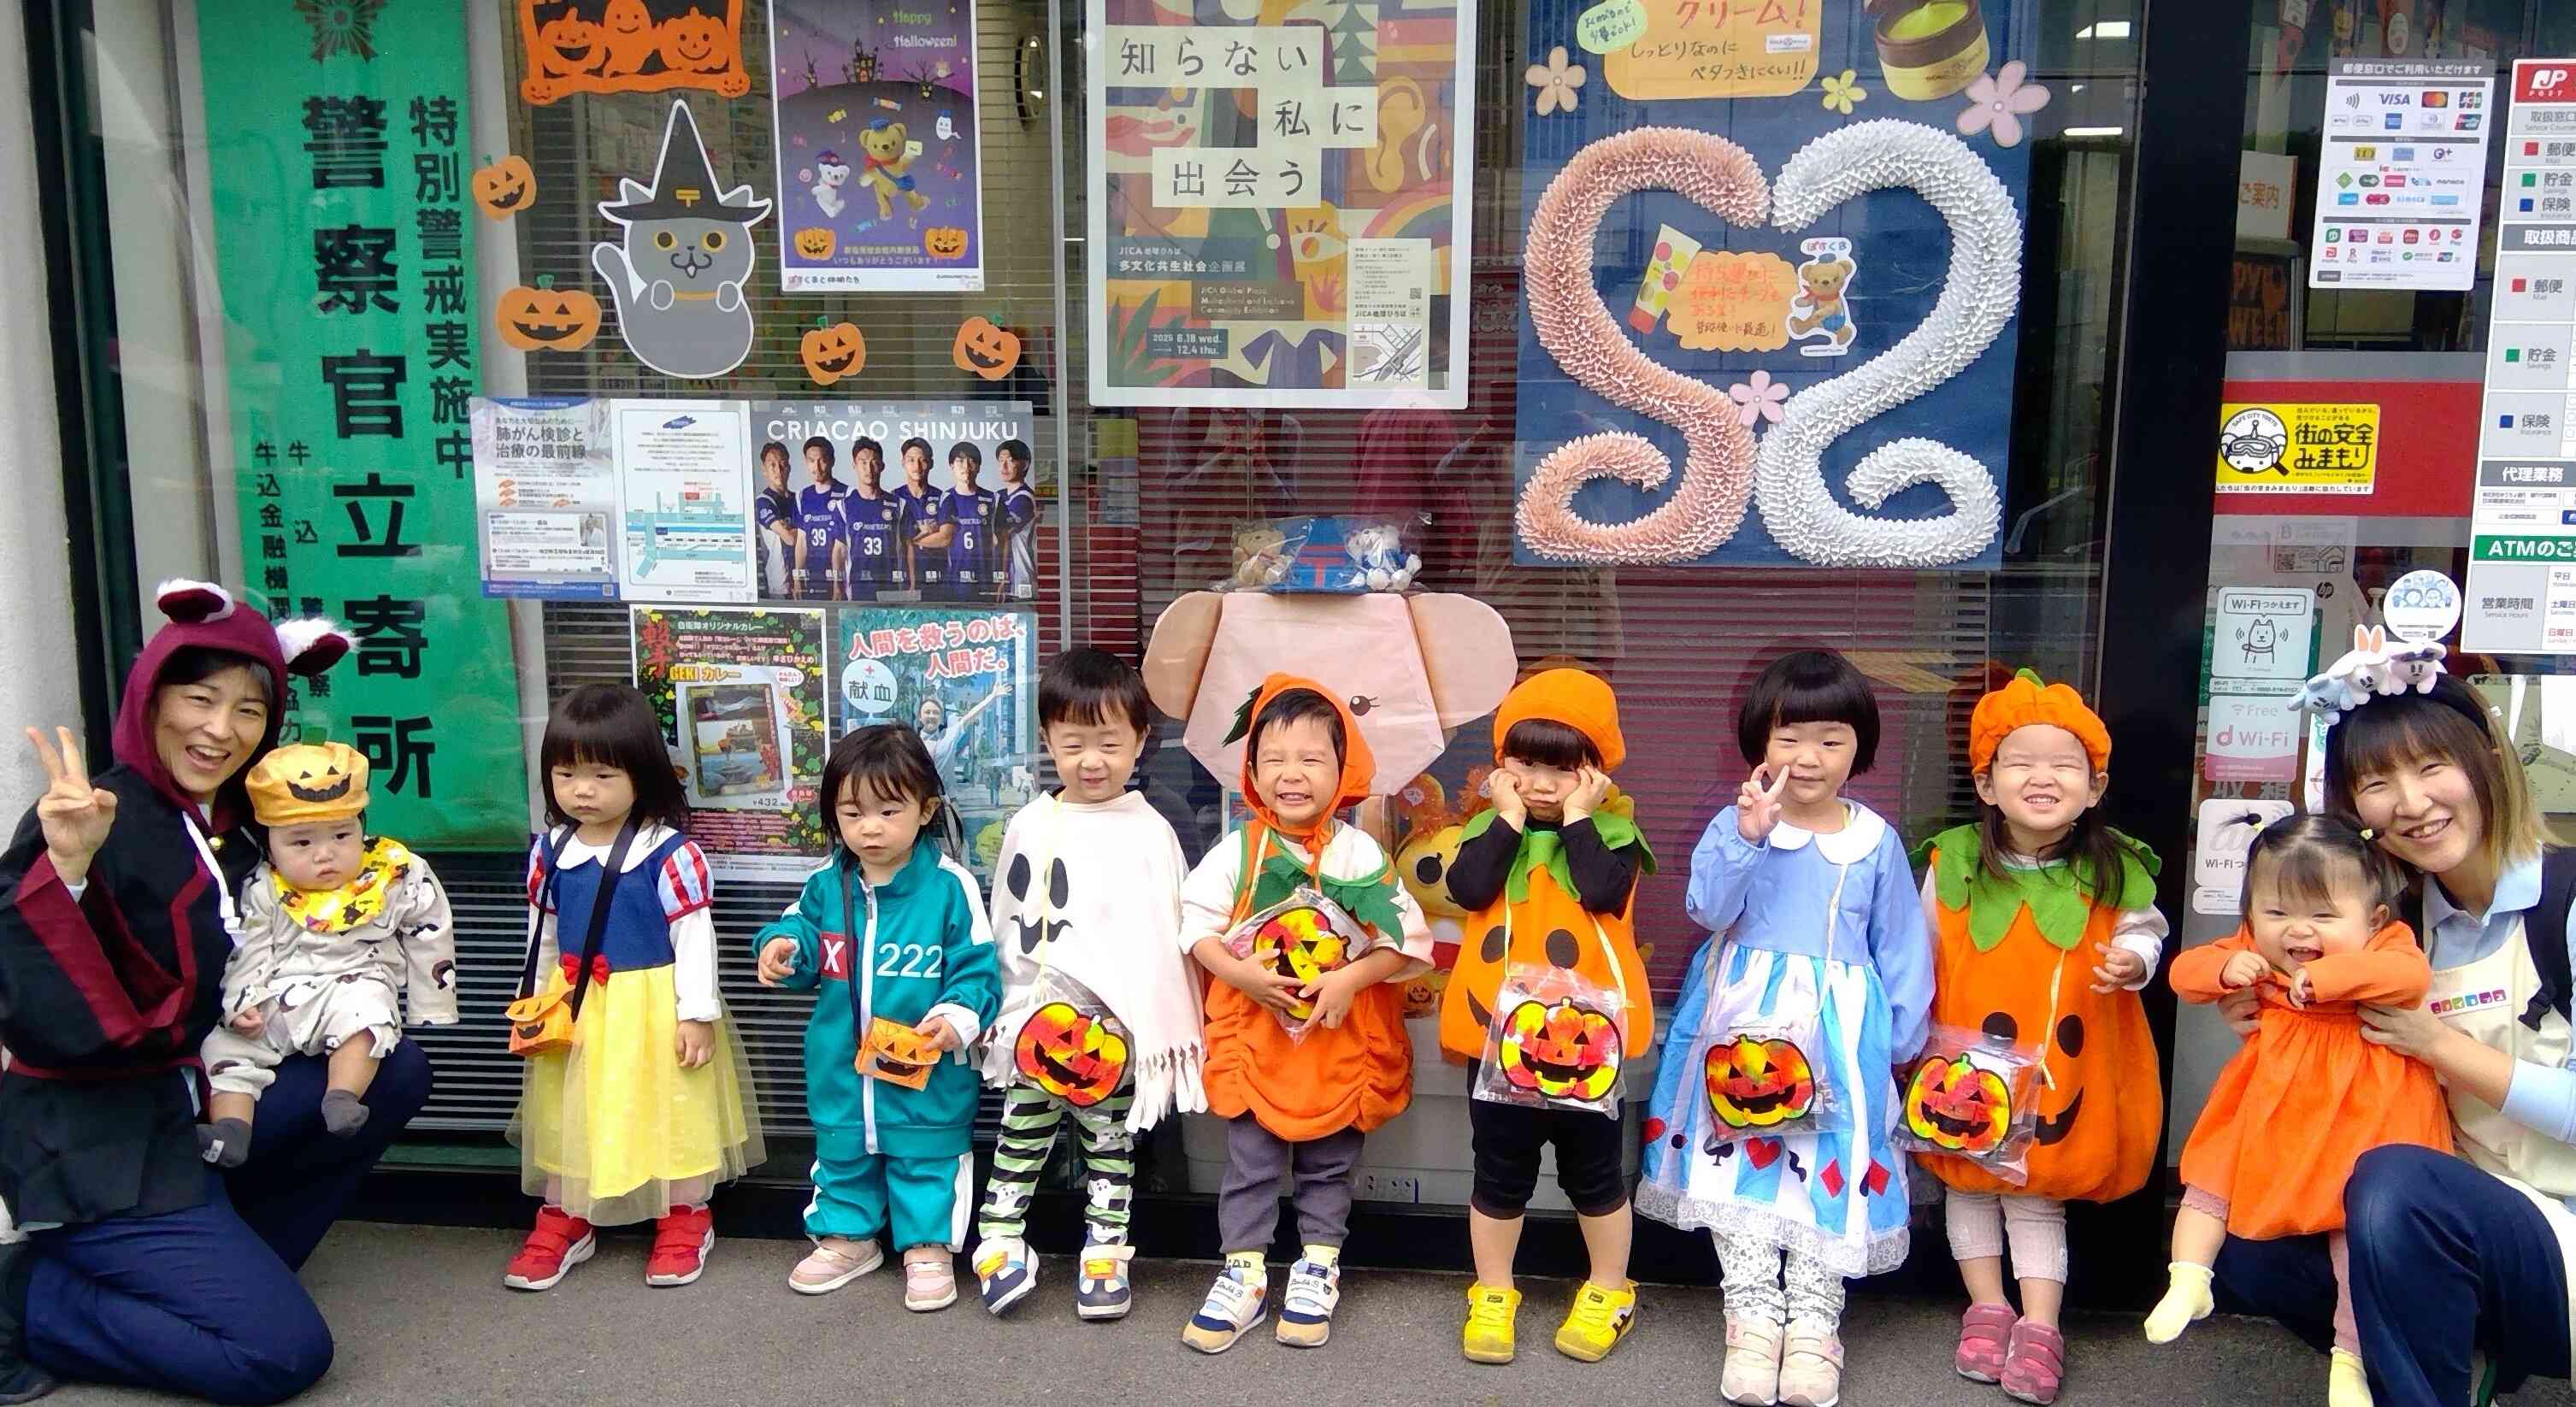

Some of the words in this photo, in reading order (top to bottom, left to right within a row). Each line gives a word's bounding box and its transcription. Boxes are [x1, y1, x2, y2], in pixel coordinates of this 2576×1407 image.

[893, 11, 932, 25] Happy
[893, 34, 958, 48] Halloween!
[1121, 37, 1308, 76] 知らない
[1630, 41, 1739, 59] しっとりなのに
[2343, 63, 2482, 75] 郵便窓口でご利用いただけます
[2379, 94, 2410, 105] VISA
[1274, 99, 1365, 138] 私に
[2546, 142, 2576, 156] 郵便
[1172, 158, 1305, 197] 出会う
[2544, 173, 2573, 186] 貯金
[2542, 197, 2571, 212] 保険
[1807, 240, 1848, 250] ぽすくま
[1119, 260, 1247, 273] 多文化共生社会企画展
[410, 95, 473, 480] 特別警戒実施中
[2533, 279, 2563, 293] 郵便
[2527, 348, 2557, 362] 貯金
[2522, 415, 2550, 428] 保険
[496, 427, 584, 442] 肺がん検診と
[767, 420, 888, 441] CRIACAO
[899, 421, 1018, 441] SHINJUKU
[2295, 423, 2373, 444] 街の安全
[302, 95, 436, 799] 警察官立寄所
[496, 443, 587, 459] 治療の最前線
[2294, 444, 2370, 470] みまもり
[2502, 467, 2564, 482] 代理業務
[811, 529, 827, 546] 39
[963, 532, 975, 550] 6
[864, 537, 882, 556] 33
[2482, 598, 2534, 610] 営業時間
[2551, 600, 2576, 609] 土曜日
[849, 615, 1026, 660] 人間を救うのは、
[2549, 628, 2573, 637] 日曜日
[926, 647, 1008, 680] 人間だ。
[669, 666, 699, 682] GEKI
[701, 667, 742, 682] カレー
[848, 680, 893, 703] 献血
[2249, 705, 2278, 716] Free
[2239, 732, 2289, 746] Wi-Fi
[823, 939, 846, 973] X
[875, 943, 942, 978] 222
